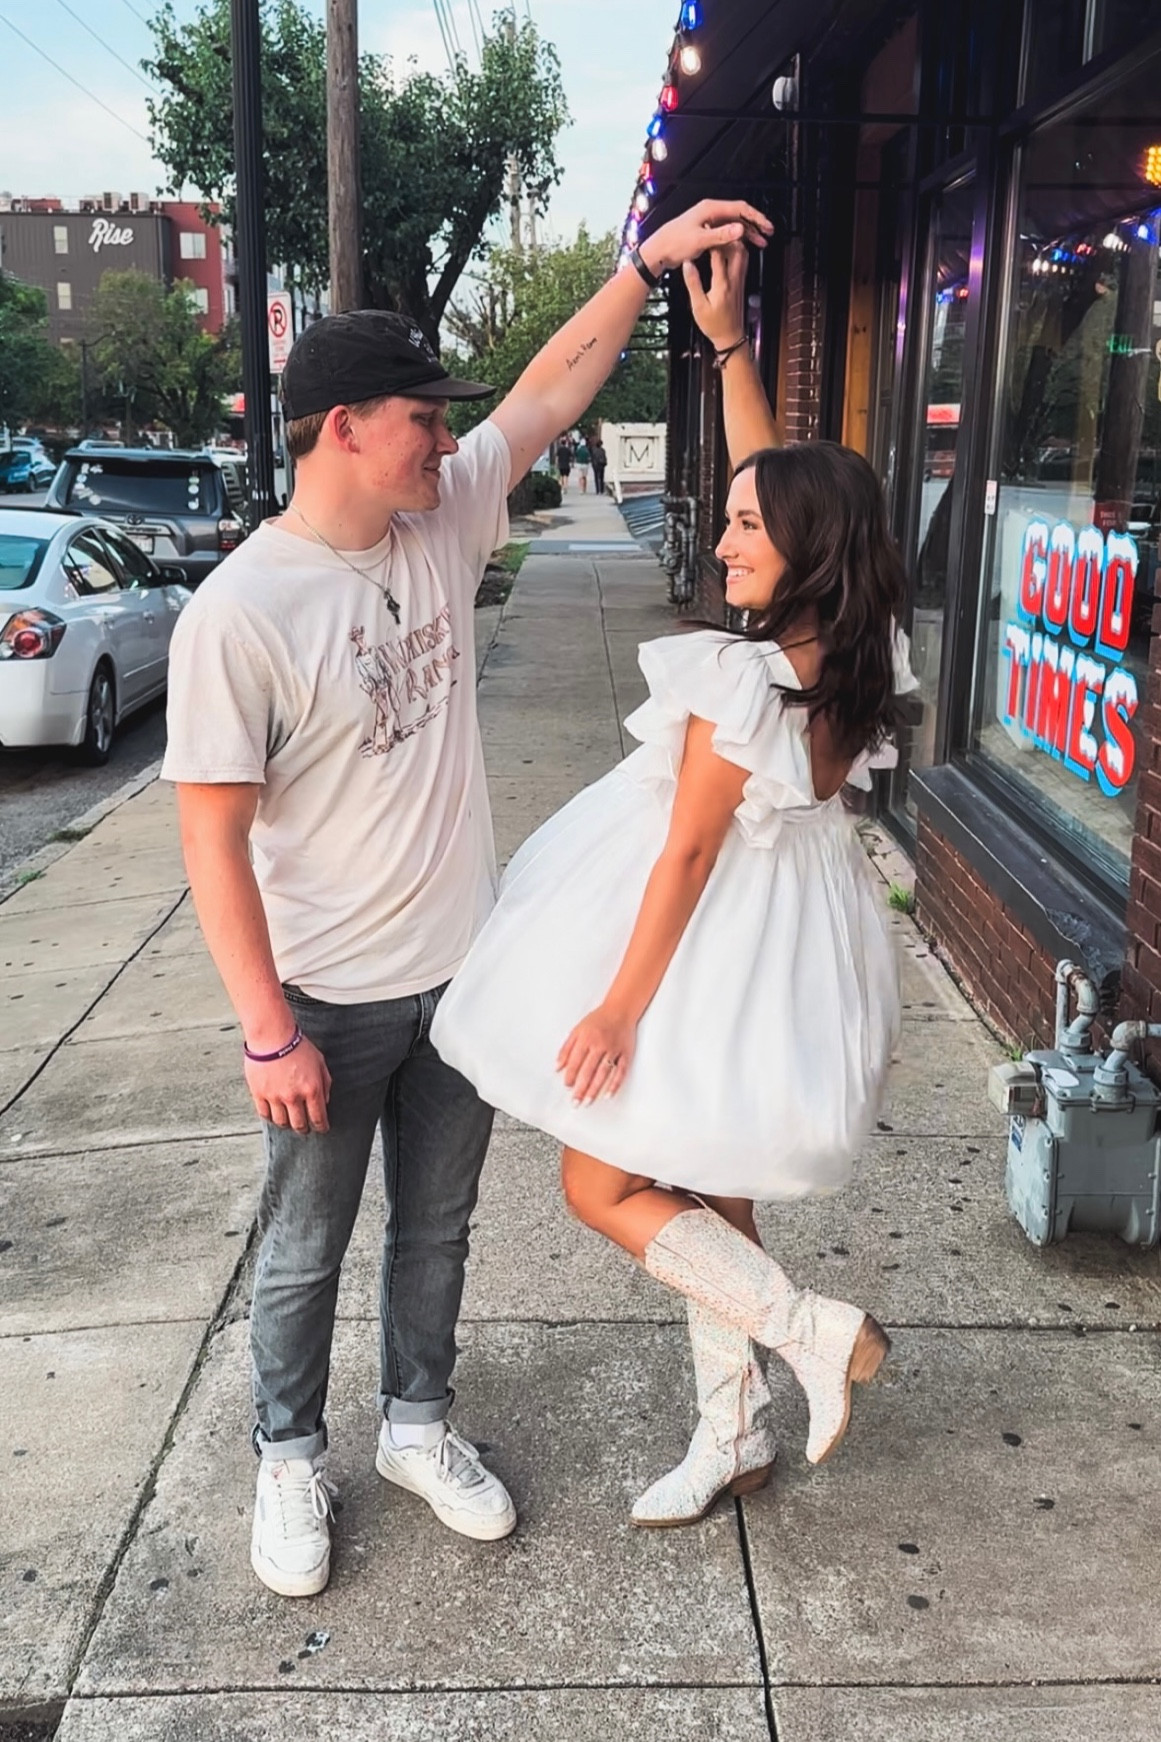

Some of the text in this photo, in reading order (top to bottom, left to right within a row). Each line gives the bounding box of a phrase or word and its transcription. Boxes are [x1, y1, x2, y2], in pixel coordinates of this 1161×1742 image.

[88, 217, 134, 253] Rise
[629, 443, 649, 463] M
[1017, 518, 1138, 663] GOOD
[1002, 621, 1139, 798] TIMES
